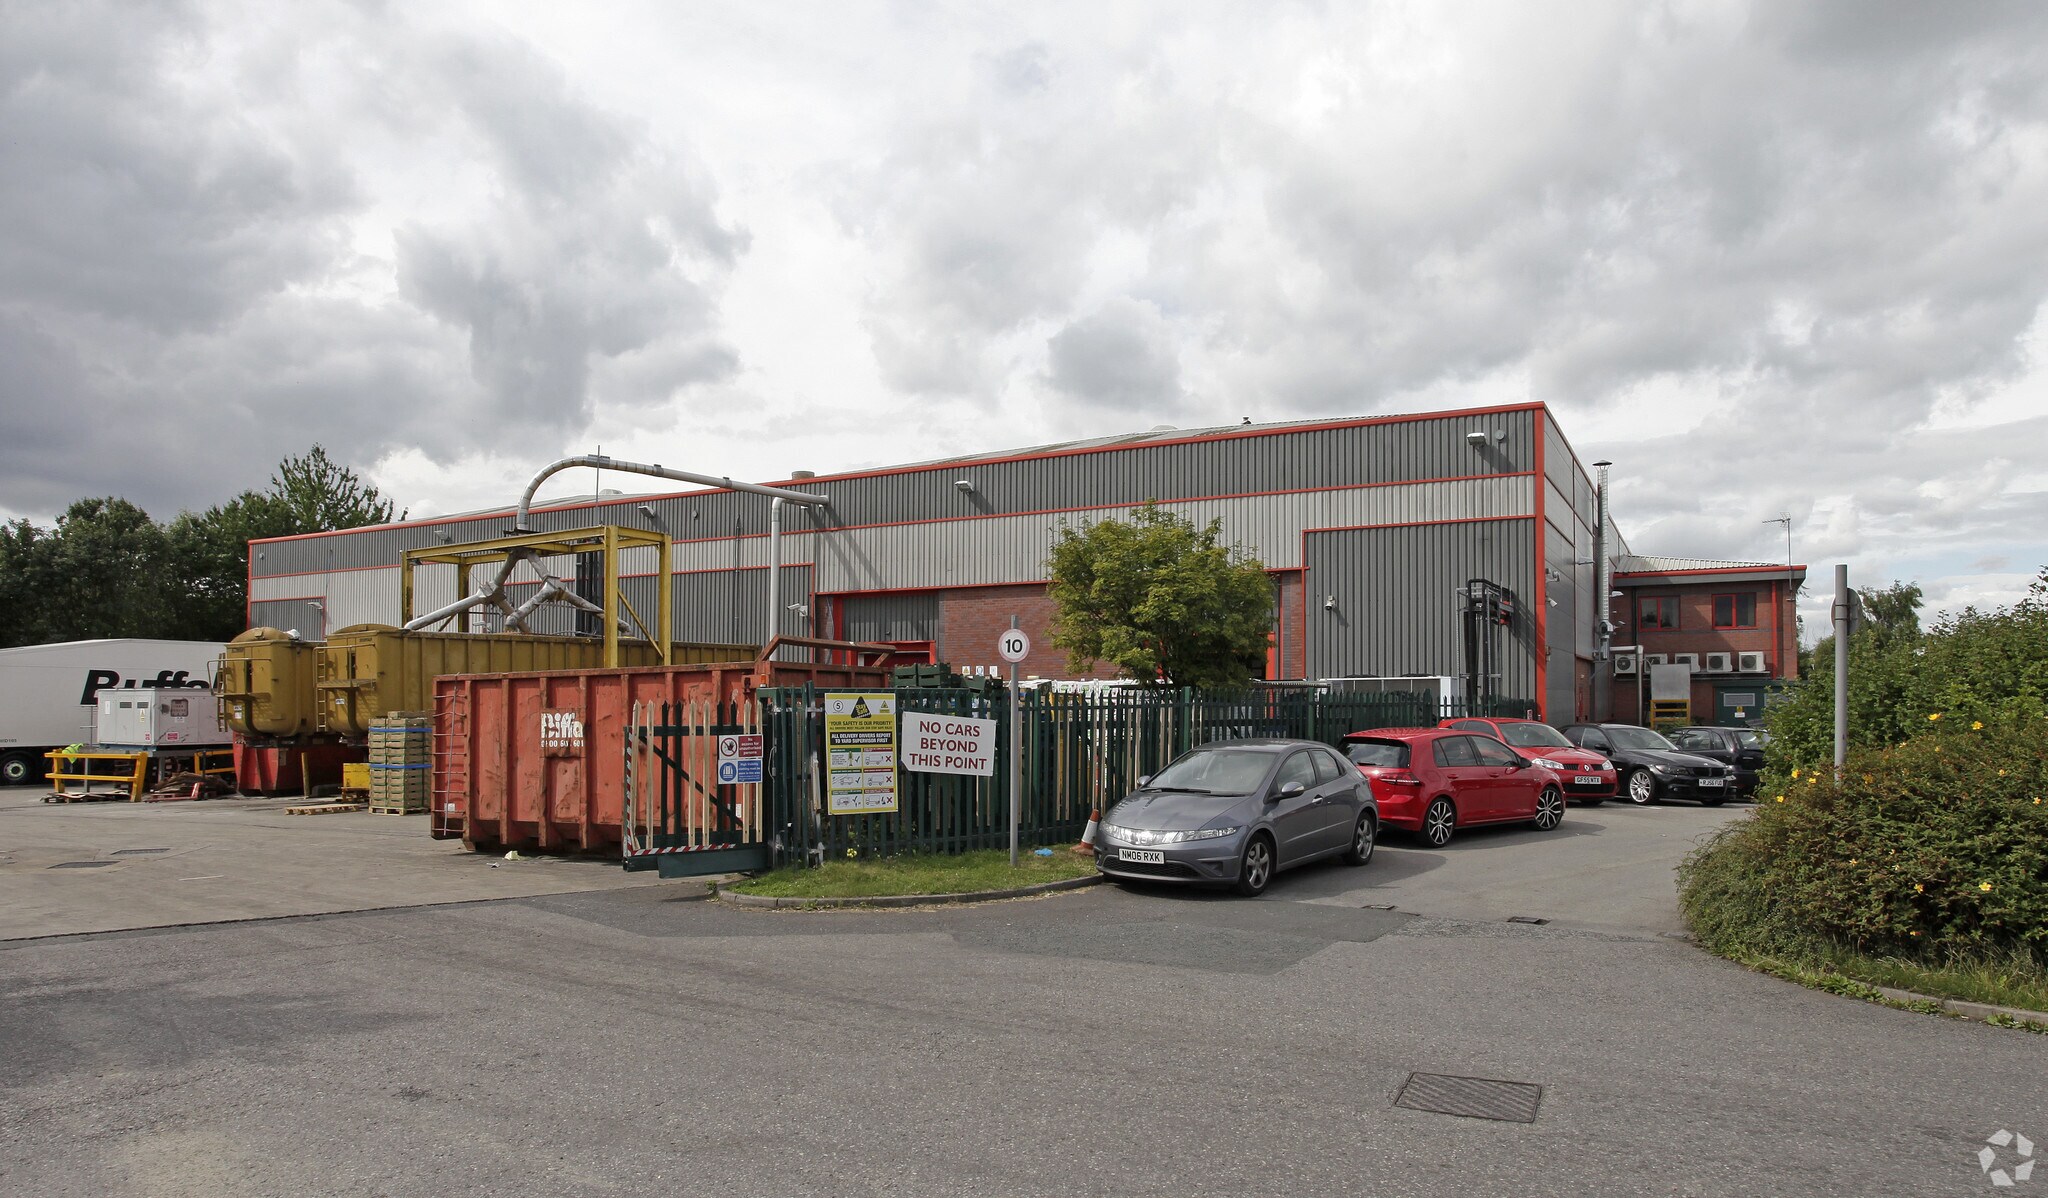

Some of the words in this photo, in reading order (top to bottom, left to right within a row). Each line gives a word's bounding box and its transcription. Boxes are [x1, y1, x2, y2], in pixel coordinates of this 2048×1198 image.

[1005, 639, 1023, 653] 10
[541, 712, 584, 738] Biffa
[919, 720, 941, 734] NO
[945, 723, 981, 737] CARS
[920, 737, 978, 753] BEYOND
[909, 753, 941, 767] THIS
[945, 756, 987, 770] POINT
[1122, 850, 1142, 861] NM06
[1143, 852, 1160, 862] RXK
